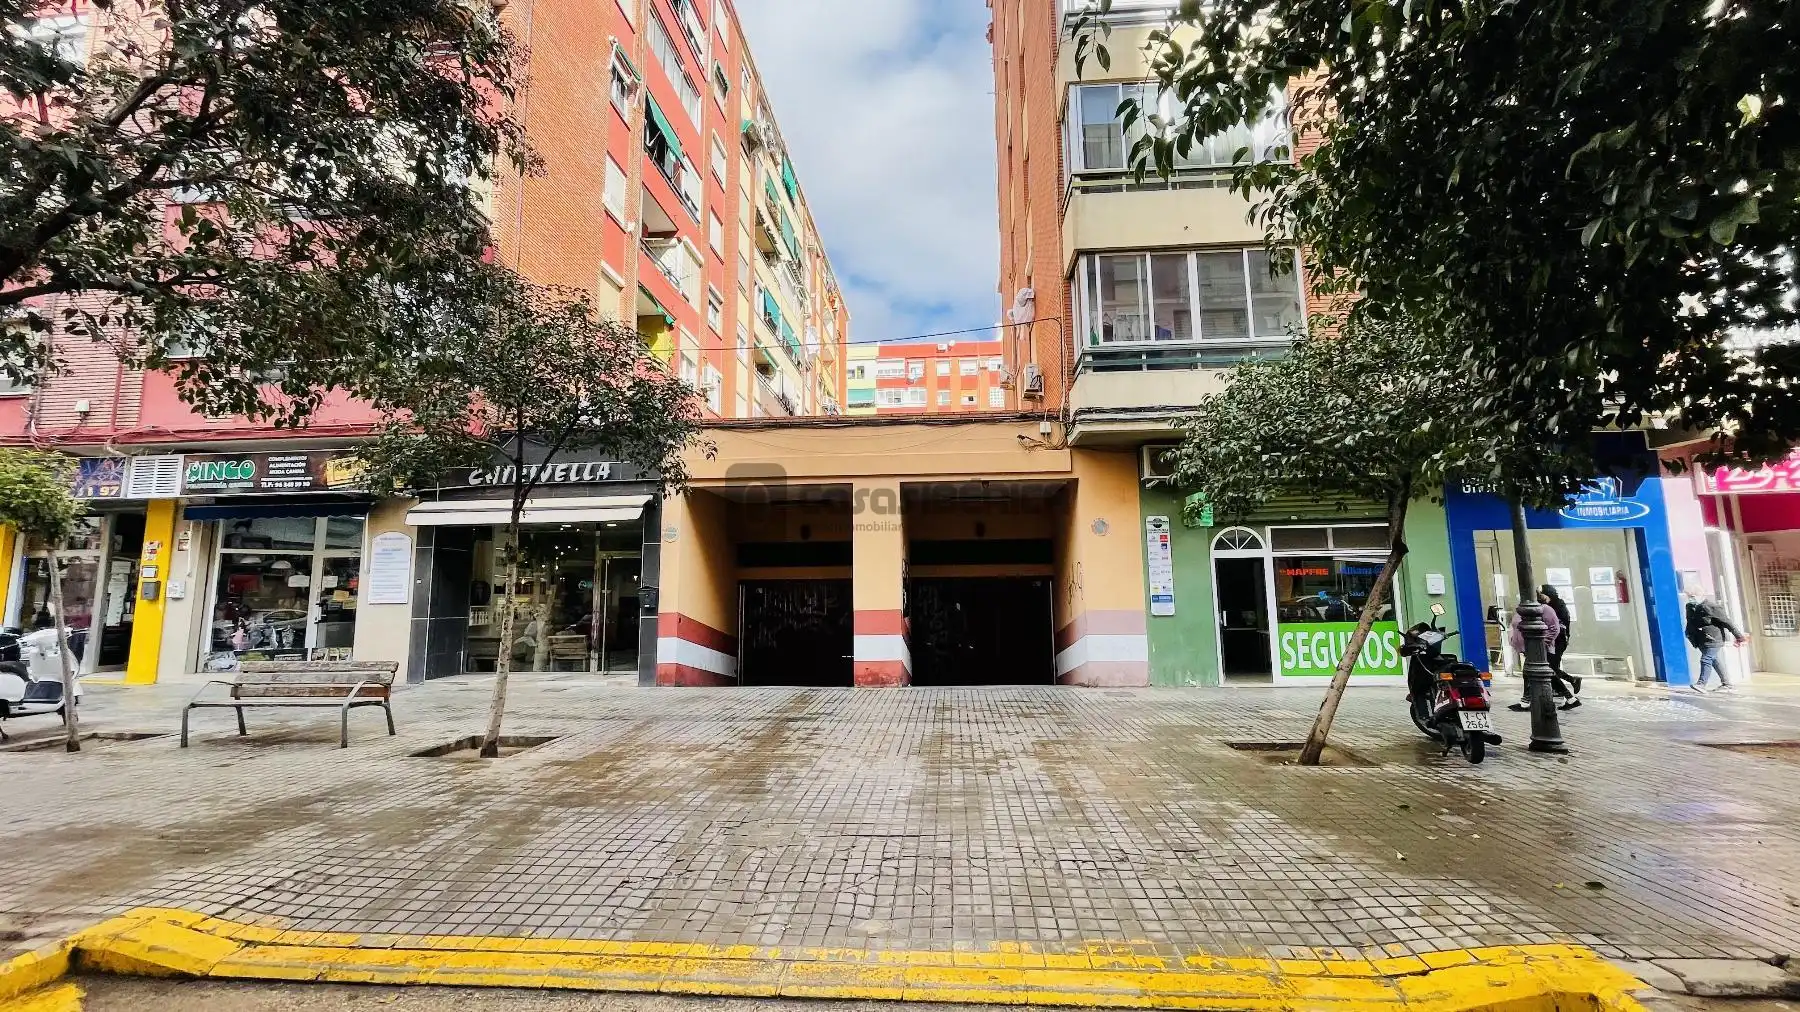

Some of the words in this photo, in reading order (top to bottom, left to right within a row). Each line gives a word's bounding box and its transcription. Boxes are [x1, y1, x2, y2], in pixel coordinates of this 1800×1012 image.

[100, 485, 120, 497] 97
[1576, 506, 1630, 517] INMOBILIARIA
[1286, 568, 1329, 576] MAPFRE
[1281, 630, 1399, 670] SEGUOS
